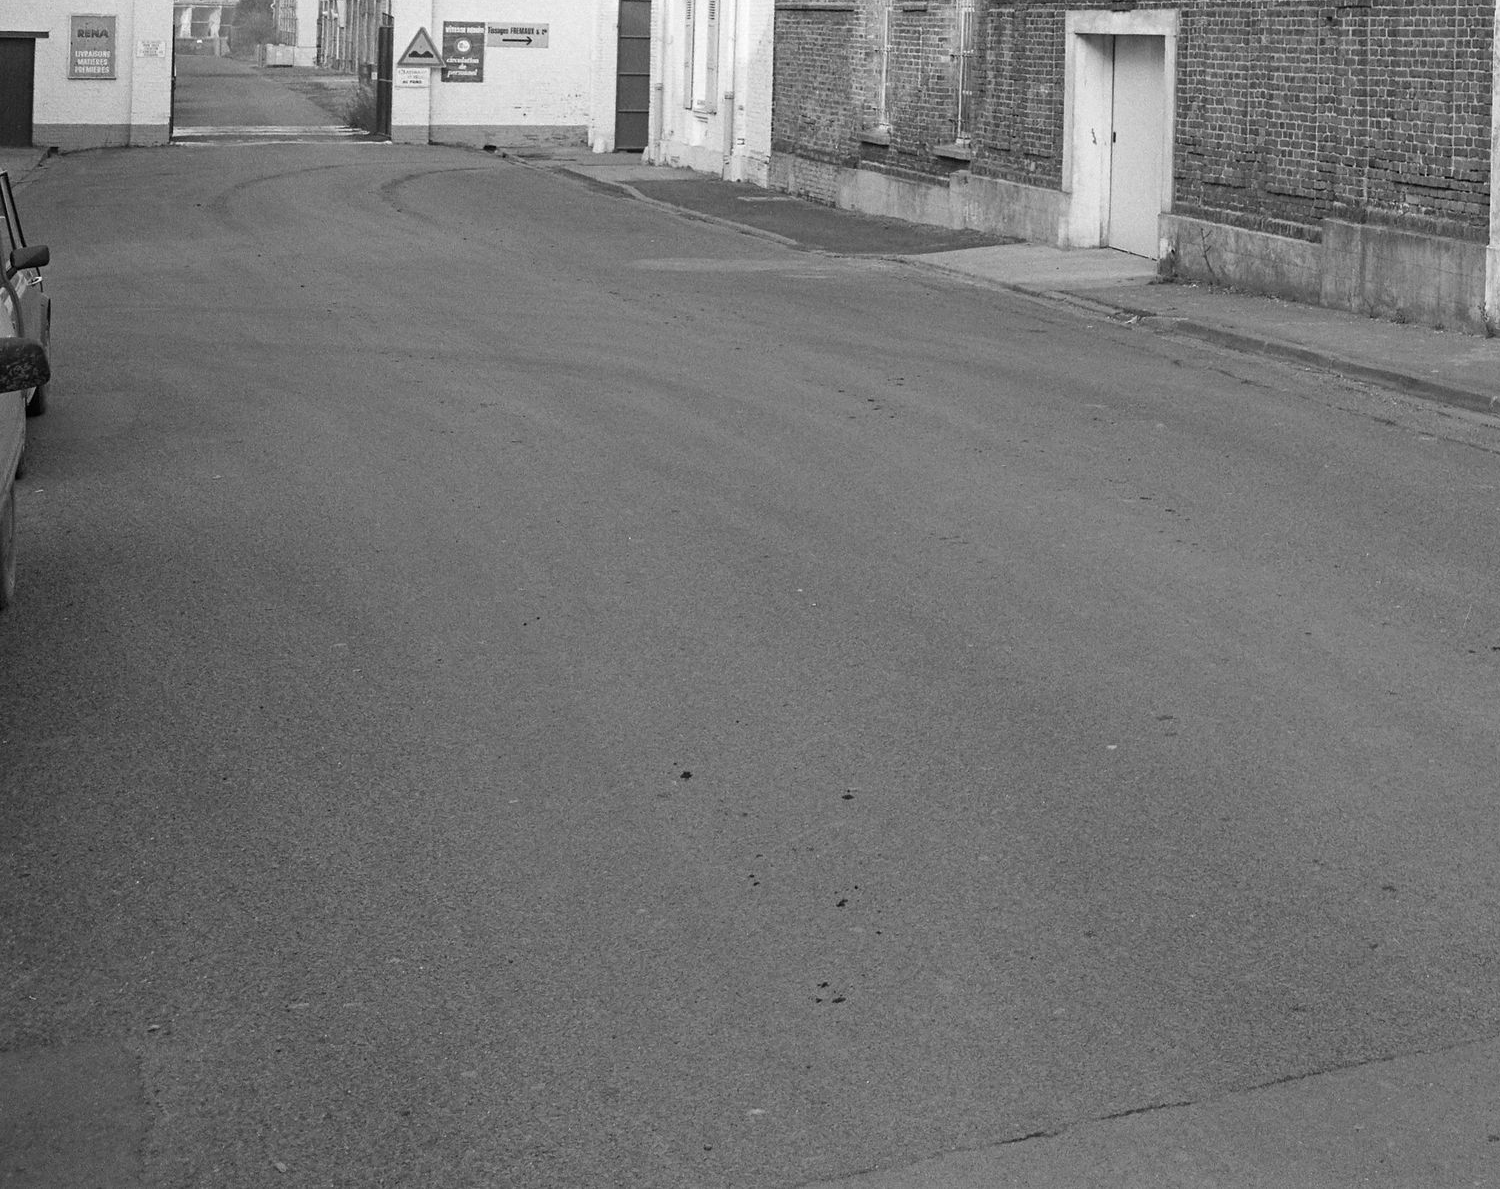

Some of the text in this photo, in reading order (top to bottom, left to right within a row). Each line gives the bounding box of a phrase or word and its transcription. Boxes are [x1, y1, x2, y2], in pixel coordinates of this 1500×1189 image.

[77, 28, 109, 38] RENA
[488, 26, 509, 35] Tissages
[510, 27, 534, 35] FREMAUX
